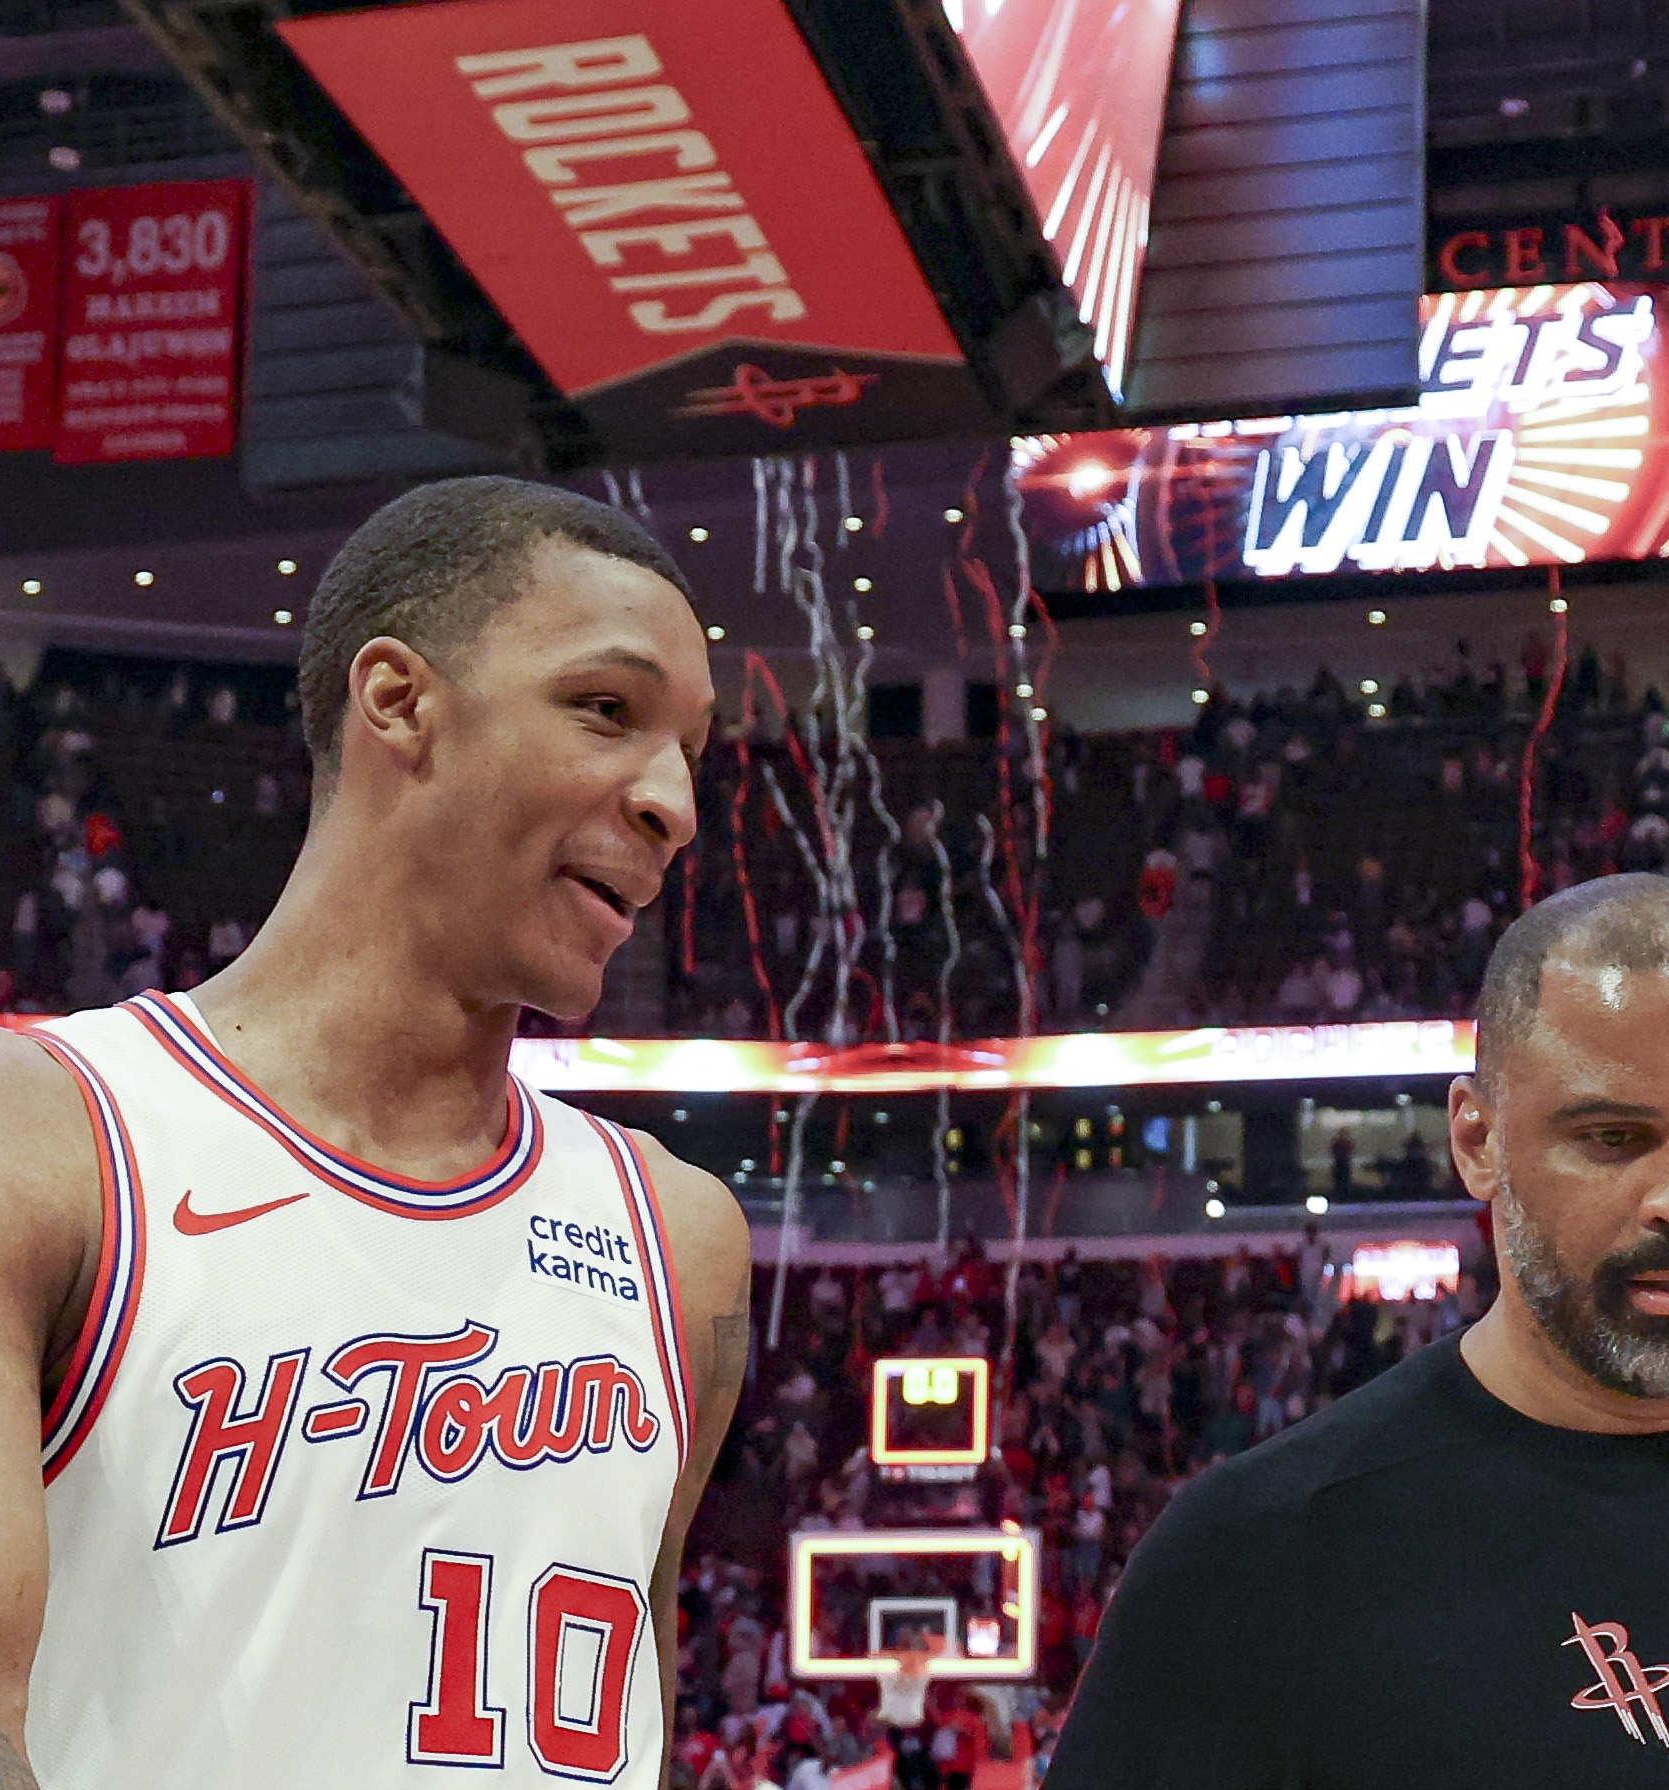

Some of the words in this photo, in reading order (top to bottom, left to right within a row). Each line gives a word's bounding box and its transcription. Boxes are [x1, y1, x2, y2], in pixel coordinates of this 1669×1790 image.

[454, 33, 806, 335] ROCKETS
[76, 210, 227, 286] 3,830
[1428, 298, 1656, 398] ETS
[1246, 430, 1513, 574] WIN
[528, 1240, 639, 1301] karma
[530, 1211, 632, 1264] credit
[154, 1319, 660, 1551] H-Town
[406, 1547, 648, 1785] 10
